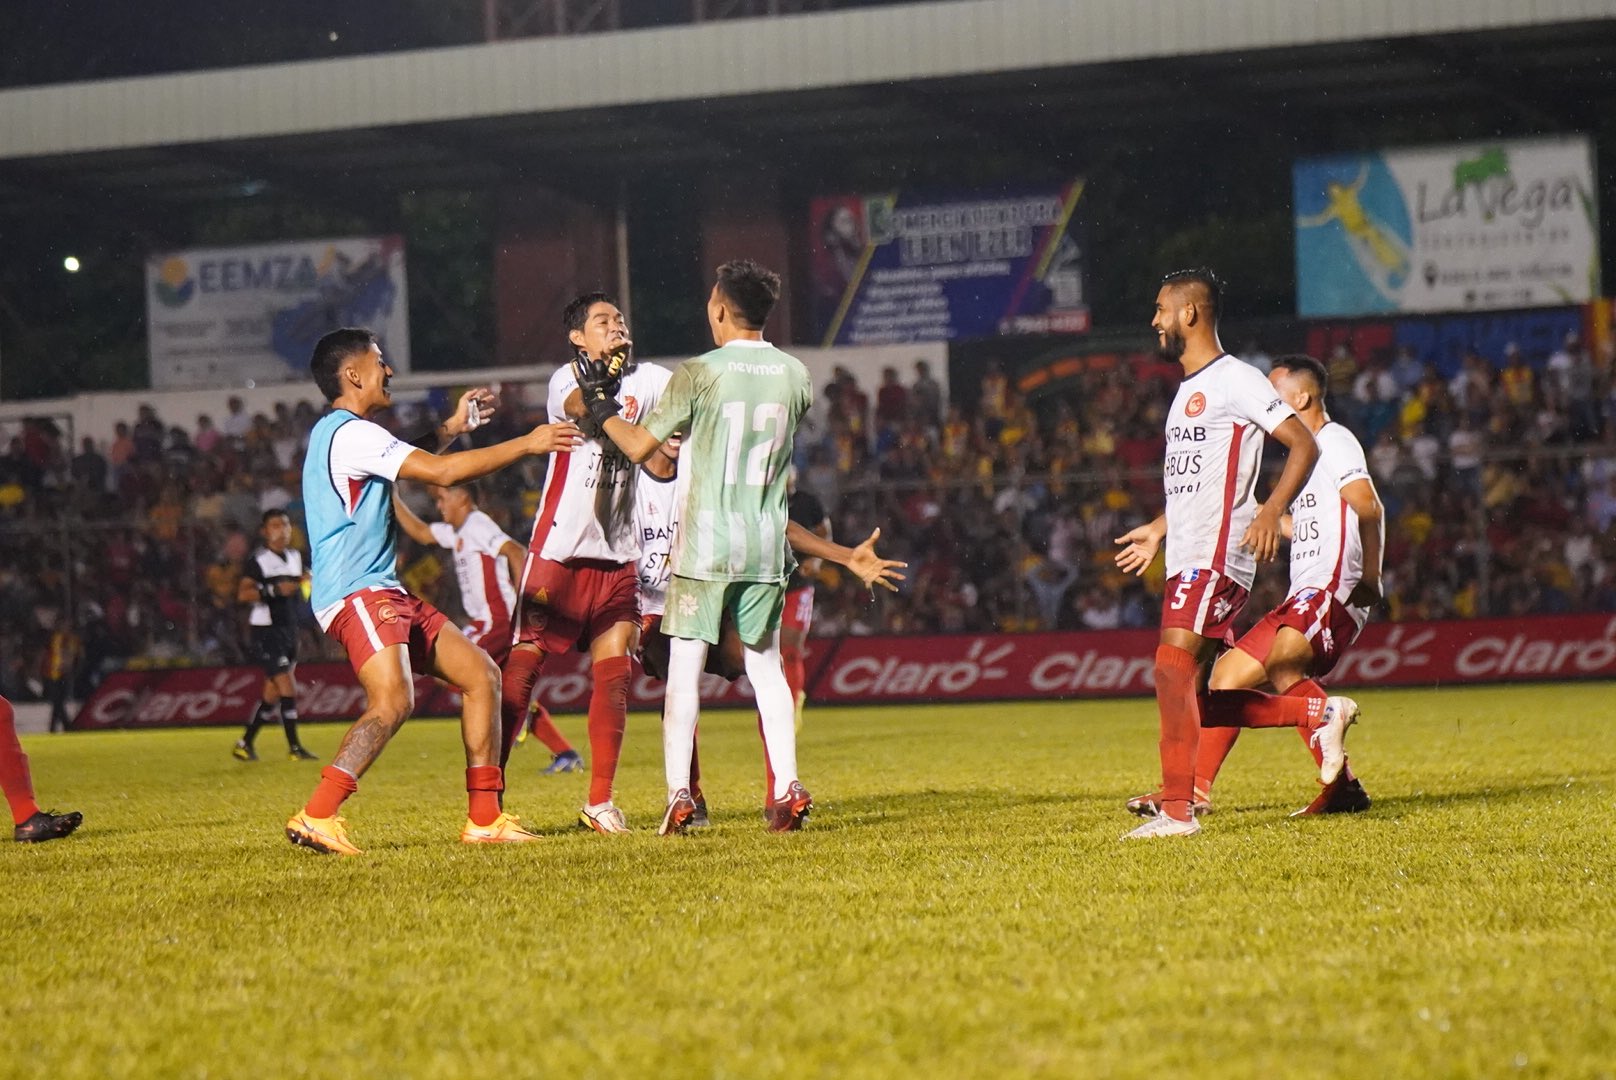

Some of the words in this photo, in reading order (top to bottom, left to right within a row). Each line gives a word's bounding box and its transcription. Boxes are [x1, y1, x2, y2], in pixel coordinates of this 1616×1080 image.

[722, 401, 788, 486] 12
[1170, 583, 1192, 610] 5
[1292, 600, 1310, 615] 4
[1455, 633, 1616, 677] Claro
[831, 656, 980, 695] Claro
